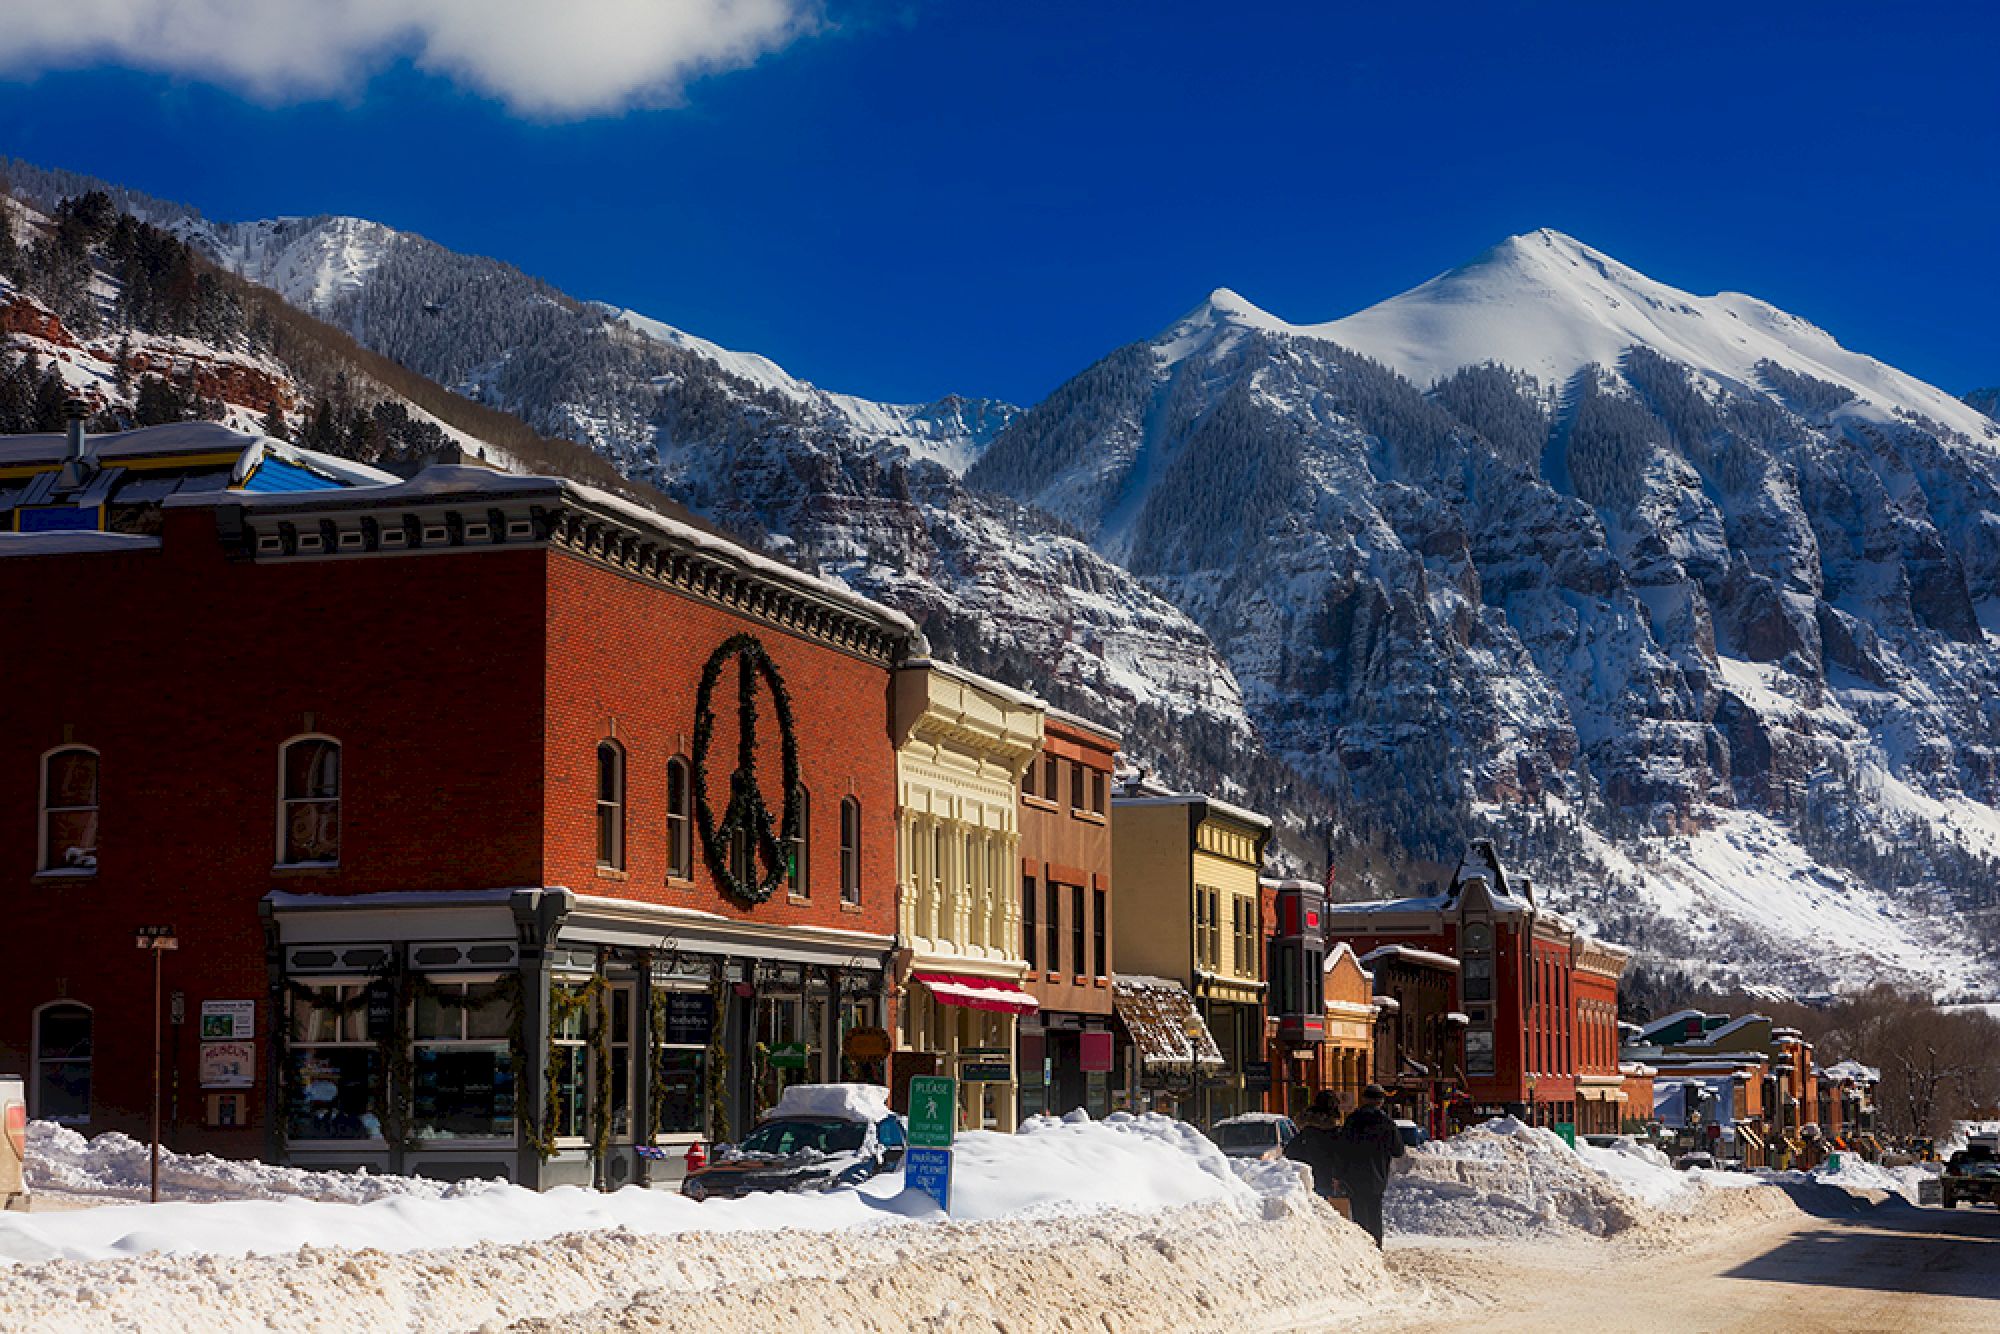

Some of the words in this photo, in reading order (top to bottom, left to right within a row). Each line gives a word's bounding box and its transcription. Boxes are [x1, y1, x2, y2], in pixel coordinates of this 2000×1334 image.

[915, 1082, 948, 1094] PLEASE
[912, 1153, 944, 1164] PARKING
[920, 1165, 946, 1175] PERMIT
